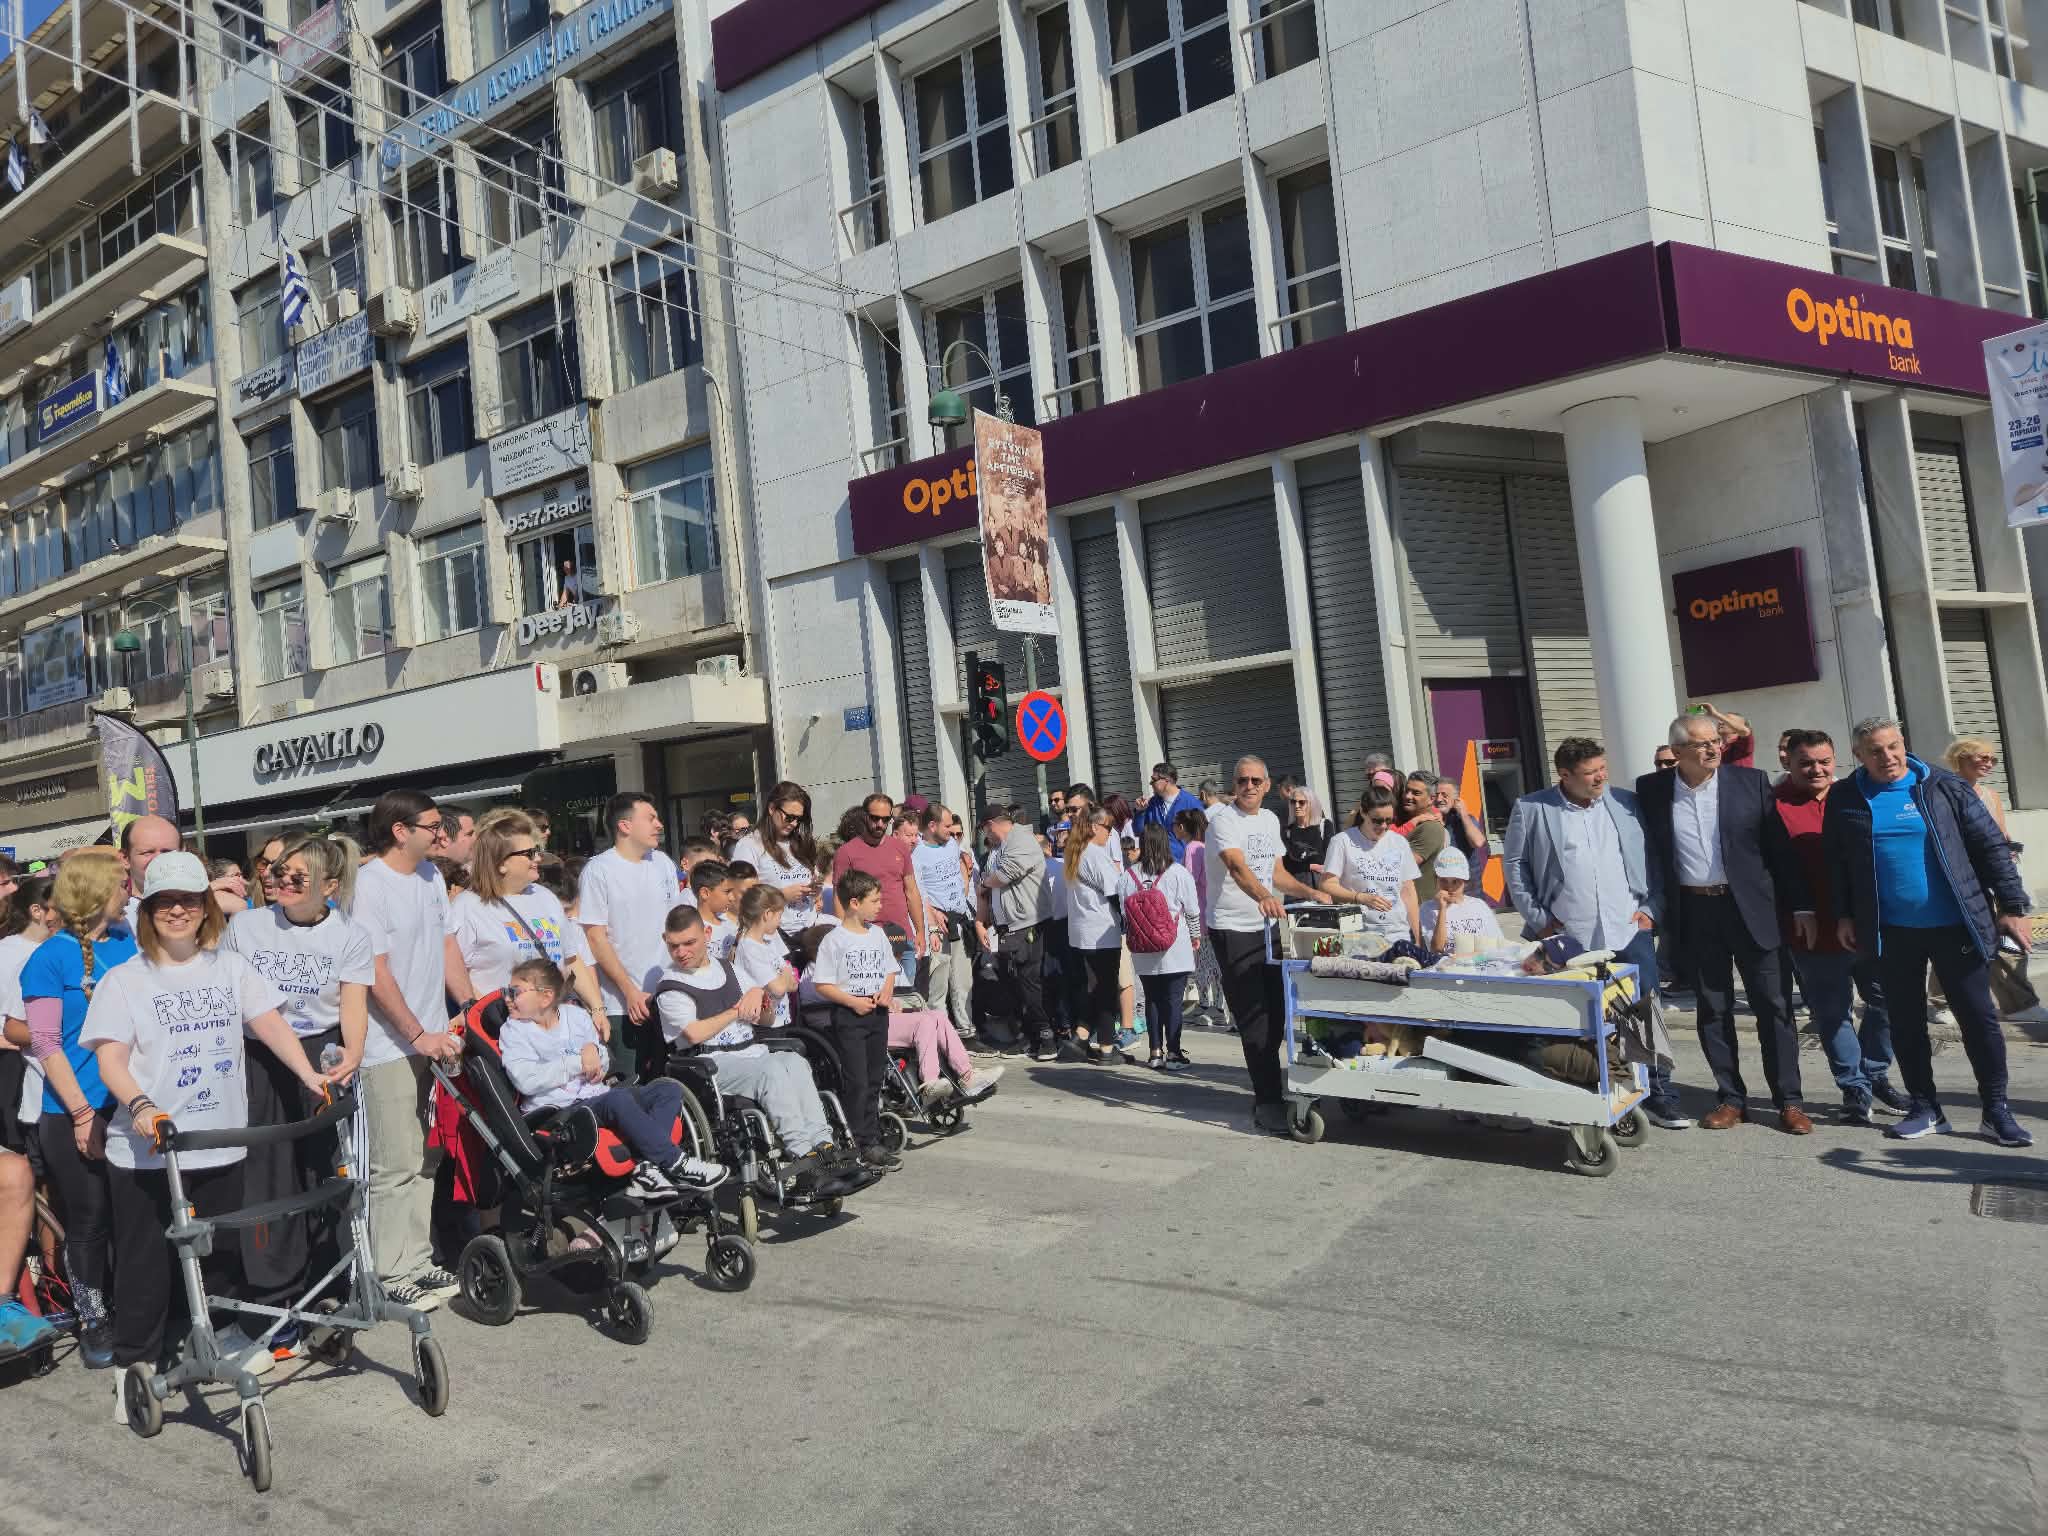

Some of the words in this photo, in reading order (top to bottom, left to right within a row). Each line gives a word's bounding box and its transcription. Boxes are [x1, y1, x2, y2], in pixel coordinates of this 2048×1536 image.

[1786, 288, 1913, 349] Optima
[1889, 347, 1922, 375] bank
[2008, 414, 2041, 431] 23-26
[903, 458, 979, 516] Opti
[1690, 587, 1780, 622] Optima
[1759, 605, 1784, 618] bank
[254, 722, 384, 774] CAVALLO
[252, 950, 332, 985] RUN
[152, 987, 237, 1026] RUN
[278, 983, 320, 996] AUTISM
[169, 1022, 190, 1035] FOR
